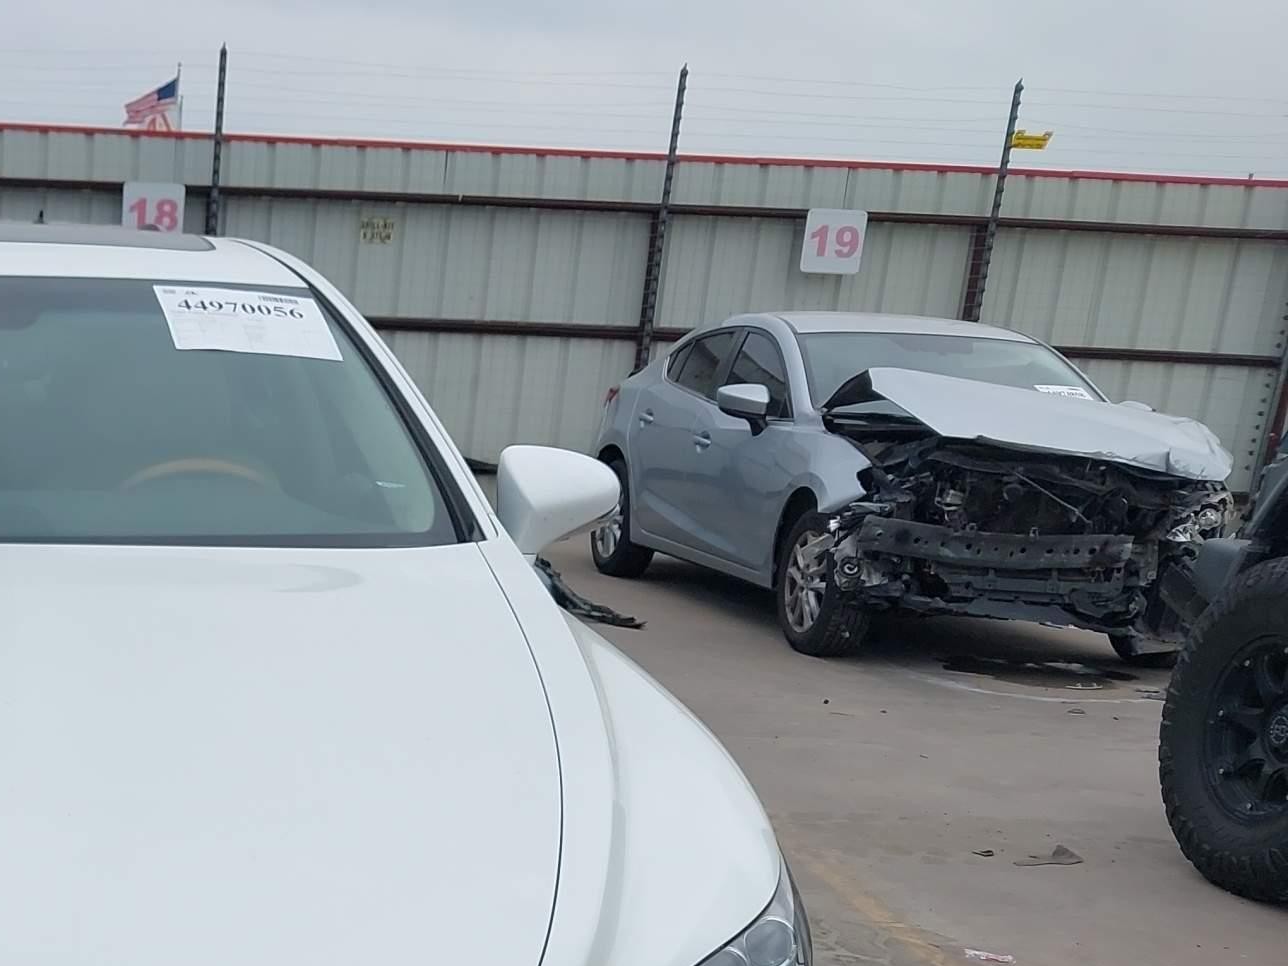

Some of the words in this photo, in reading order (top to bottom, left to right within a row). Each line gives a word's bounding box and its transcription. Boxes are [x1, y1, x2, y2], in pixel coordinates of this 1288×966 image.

[129, 197, 178, 232] 18
[810, 224, 860, 258] 19
[177, 298, 304, 320] 44970056
